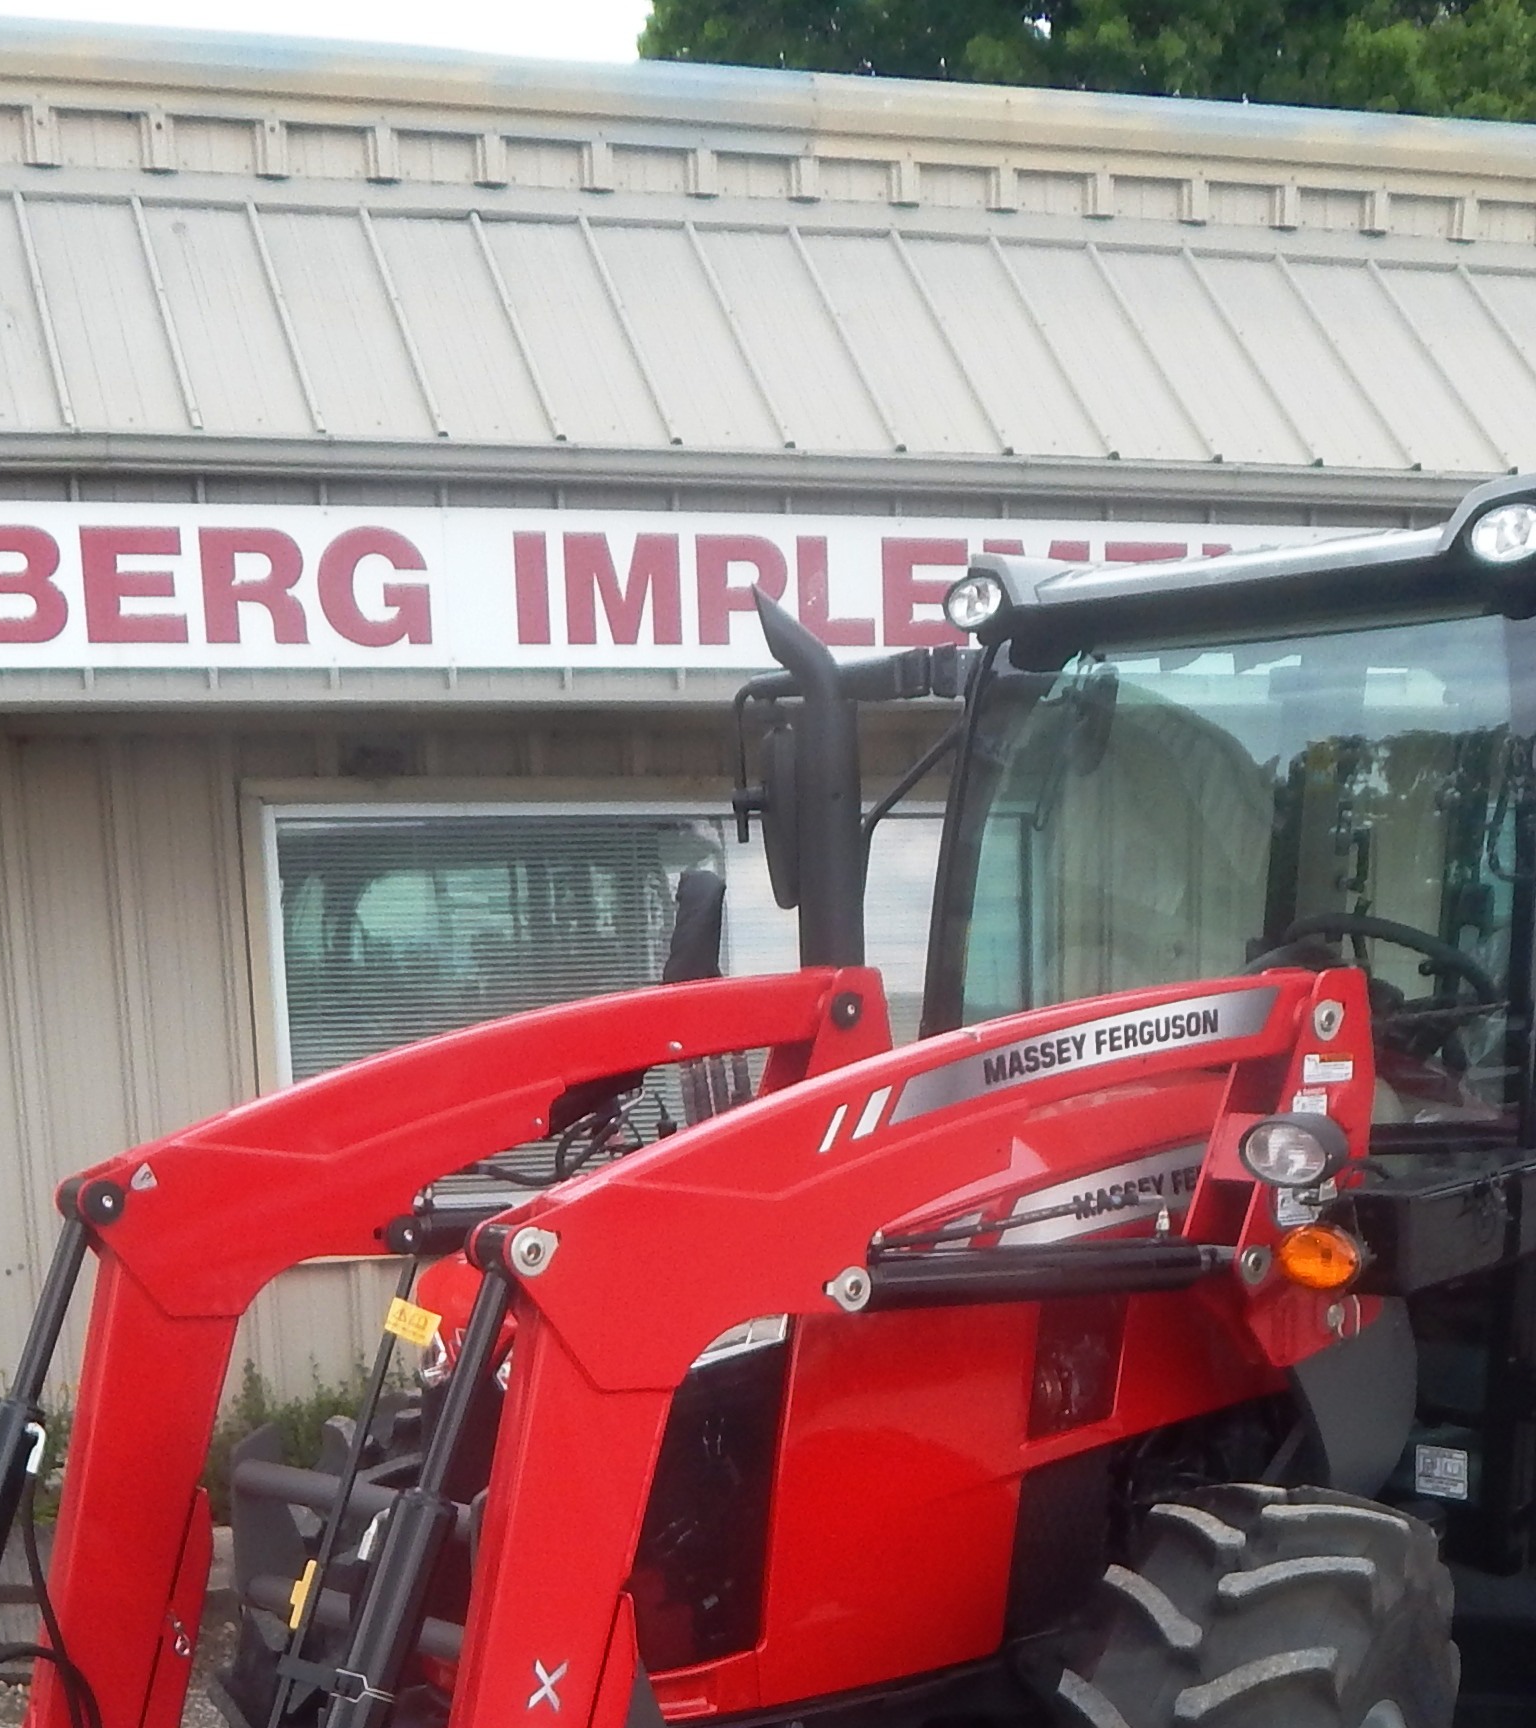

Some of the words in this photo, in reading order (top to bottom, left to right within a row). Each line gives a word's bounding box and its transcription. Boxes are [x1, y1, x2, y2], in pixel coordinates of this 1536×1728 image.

[511, 530, 1232, 648] IMPLE
[983, 1033, 1086, 1085] MASSEY
[1095, 1008, 1219, 1056] FERGUSON
[526, 1657, 570, 1713] X
